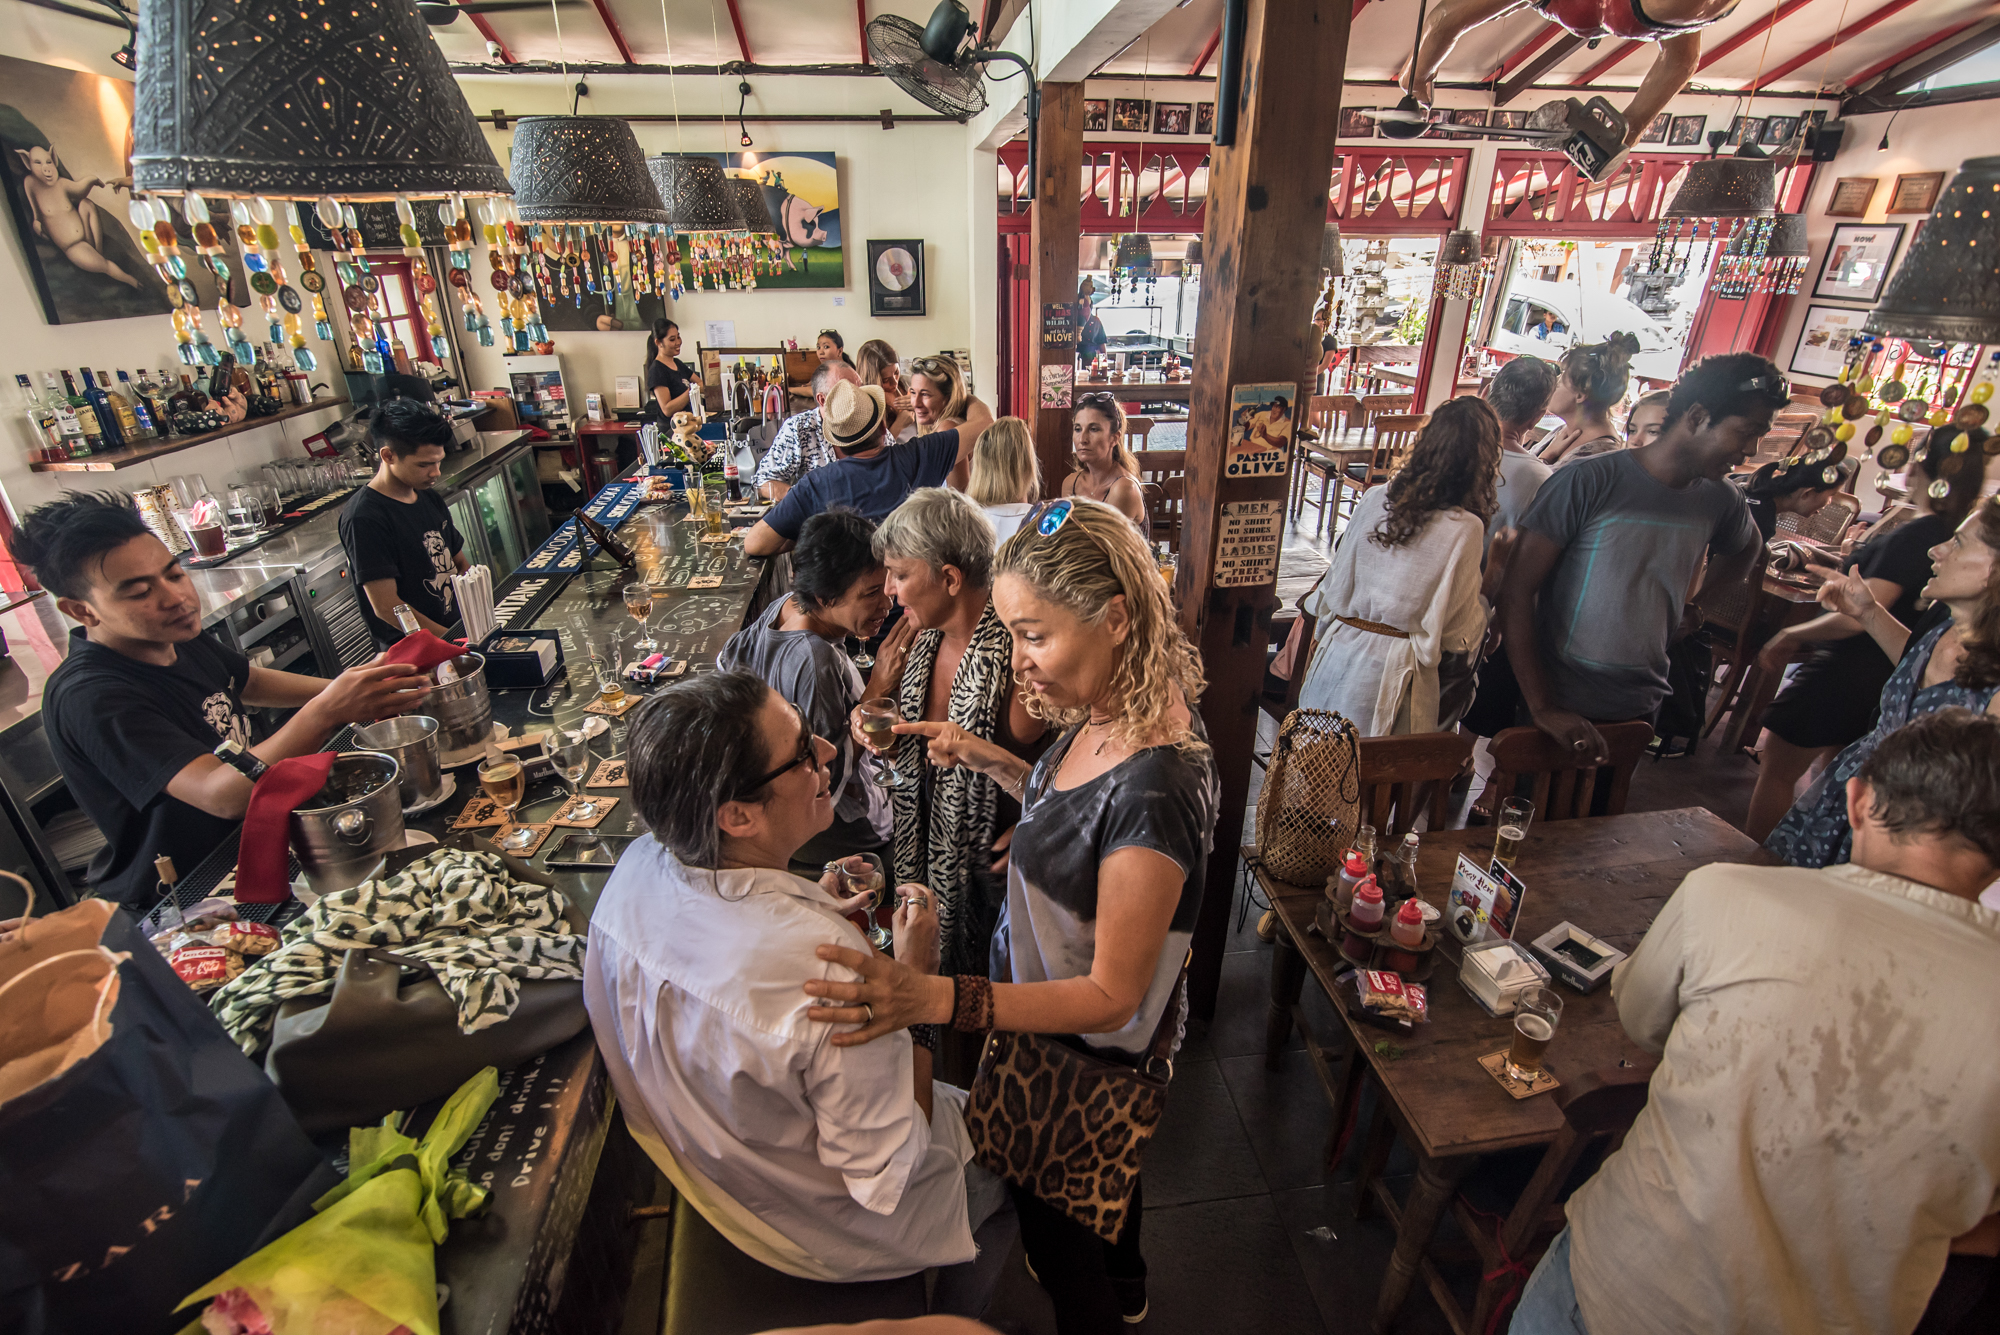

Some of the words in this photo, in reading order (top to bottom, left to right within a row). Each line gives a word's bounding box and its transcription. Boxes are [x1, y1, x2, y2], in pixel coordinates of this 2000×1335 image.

[1055, 309, 1071, 317] HAS
[1044, 334, 1052, 342] IN
[1053, 333, 1072, 342] LOVE
[1237, 452, 1279, 463] PASTIS
[1228, 462, 1285, 475] OLIVE
[594, 486, 623, 505] VODKA
[606, 503, 631, 518] SKYY
[1237, 503, 1269, 514] MEN
[1238, 535, 1276, 543] SERVICE
[1221, 545, 1276, 557] LADIES
[526, 549, 558, 569] SKYY
[1240, 558, 1271, 567] SHIRT
[1231, 568, 1260, 576] FREE
[1225, 575, 1264, 584] DRINKS
[1497, 1073, 1518, 1090] BALI
[510, 1068, 540, 1115] drink
[511, 1125, 548, 1189] Drive
